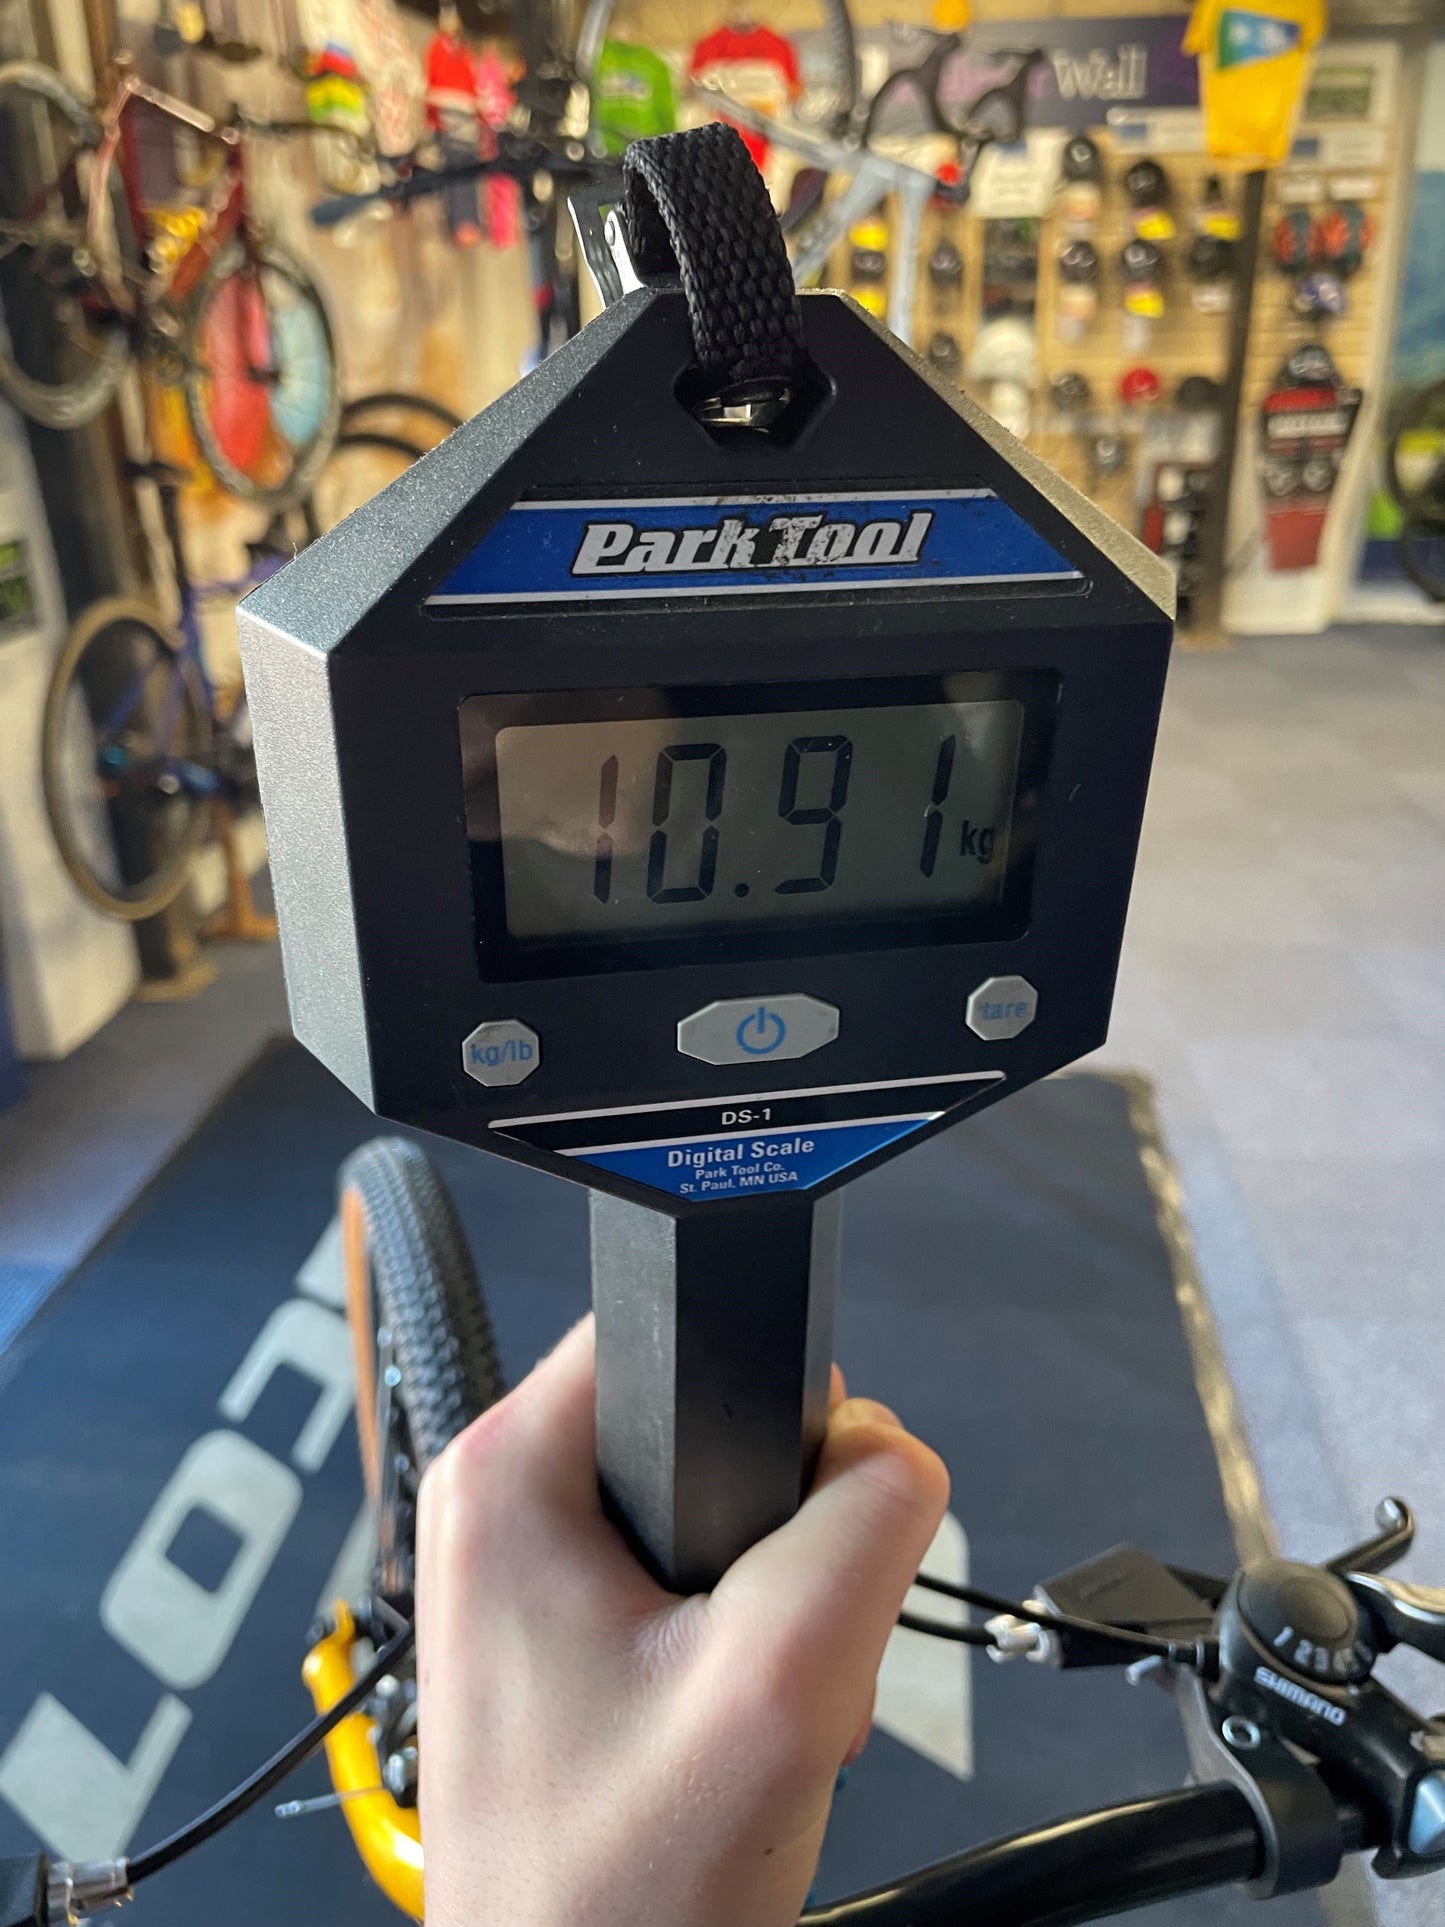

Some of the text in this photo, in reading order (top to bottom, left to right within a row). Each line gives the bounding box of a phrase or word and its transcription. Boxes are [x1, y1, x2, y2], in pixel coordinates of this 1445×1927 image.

[1053, 44, 1148, 100] Wall
[572, 512, 933, 575] Park Tool
[593, 734, 995, 904] 10.91 kg
[981, 1001, 1027, 1020] tare
[470, 1039, 533, 1067] kg/lb
[721, 1108, 772, 1126] DS-1
[668, 1137, 815, 1169] Digital Scale
[680, 1182, 697, 1194] St.
[739, 1175, 765, 1187] MN
[768, 1171, 799, 1183] USA
[695, 1161, 785, 1180] Park Tool Co.
